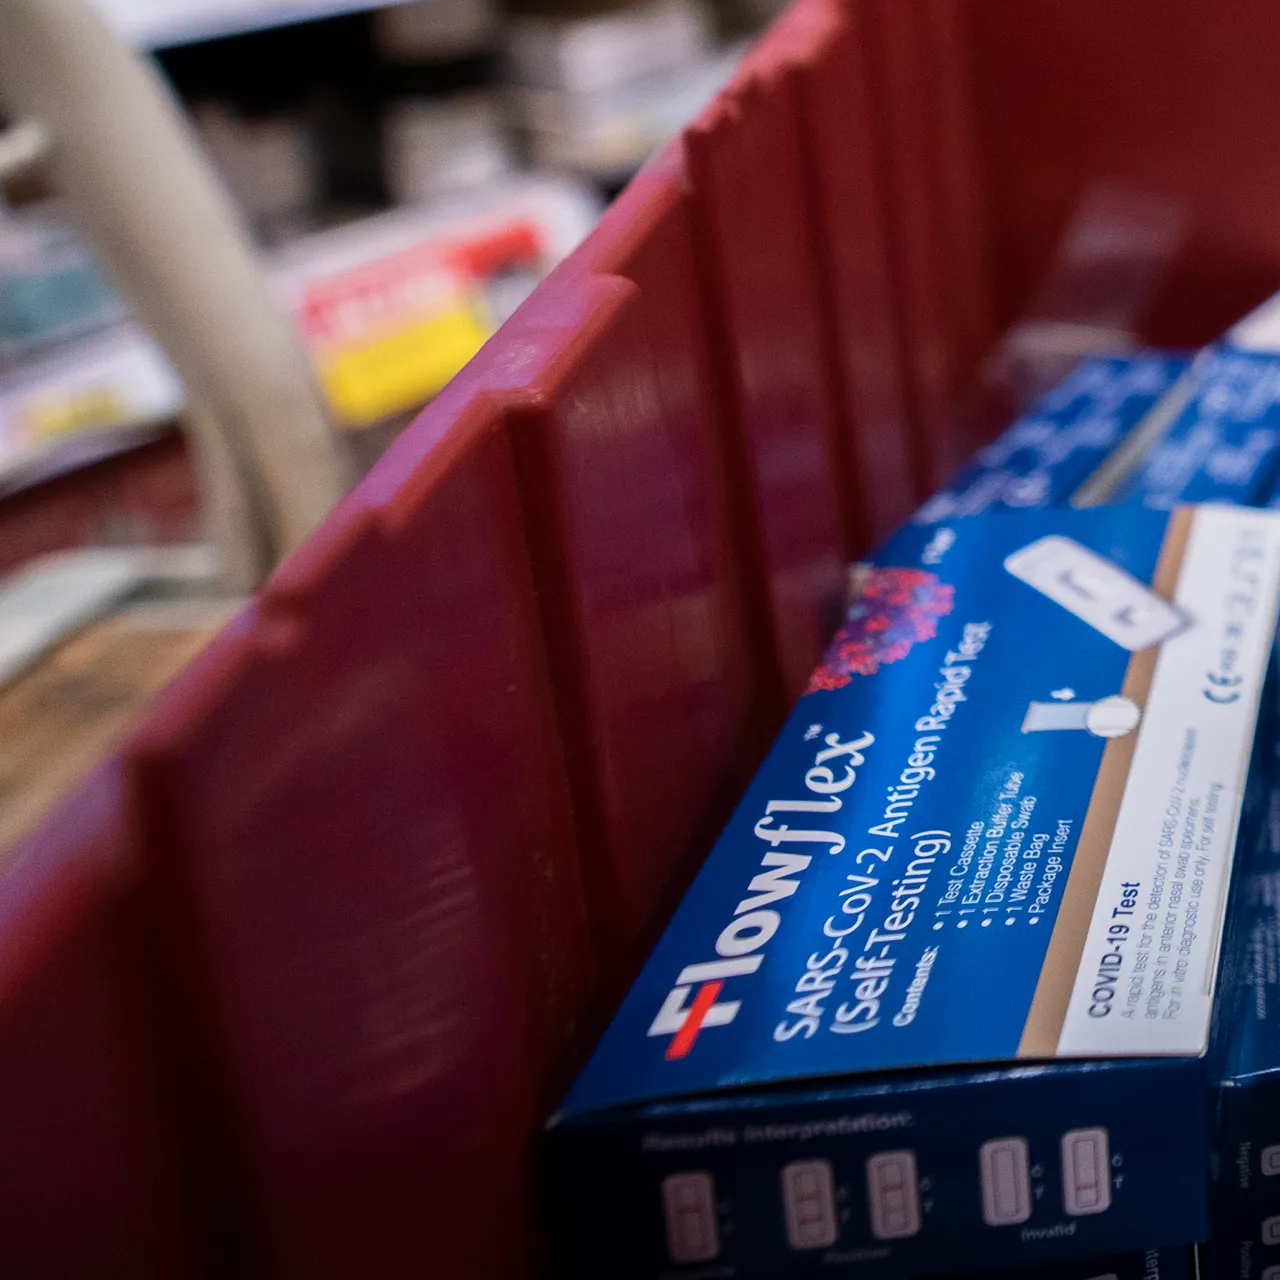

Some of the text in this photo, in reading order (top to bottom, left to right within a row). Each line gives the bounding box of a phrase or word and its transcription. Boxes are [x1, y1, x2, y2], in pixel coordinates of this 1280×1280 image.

[774, 622, 991, 1041] SARS-CoV-2 Antigen Rapid Test
[950, 821, 984, 876] Cassette
[961, 840, 1000, 904] Extraction
[986, 803, 1012, 838] Buffer
[999, 772, 1024, 801] Tube
[985, 832, 1024, 903] Disposable
[1010, 796, 1037, 829] Swab
[1157, 850, 1171, 860] of
[938, 879, 964, 906] Test
[1008, 862, 1037, 902] Waste
[1023, 834, 1050, 858] Bag
[1028, 820, 1072, 913] Package Insert
[1147, 863, 1167, 910] detection
[1185, 877, 1205, 898] use
[649, 732, 876, 1059] Flowflex
[1142, 913, 1157, 930] the
[830, 830, 951, 1033] (Self-Testing)
[1088, 883, 1140, 1018] COVID-19 Test
[1136, 933, 1152, 948] for
[1145, 968, 1166, 1019] antigens
[1159, 912, 1176, 952] anterior
[1168, 882, 1183, 908] nasal
[1177, 901, 1199, 956] diagnostic
[893, 946, 939, 1026] Contents:
[1133, 951, 1149, 973] test
[1172, 960, 1188, 983] vitro
[1127, 975, 1144, 1006] rapid
[1162, 998, 1180, 1019] For
